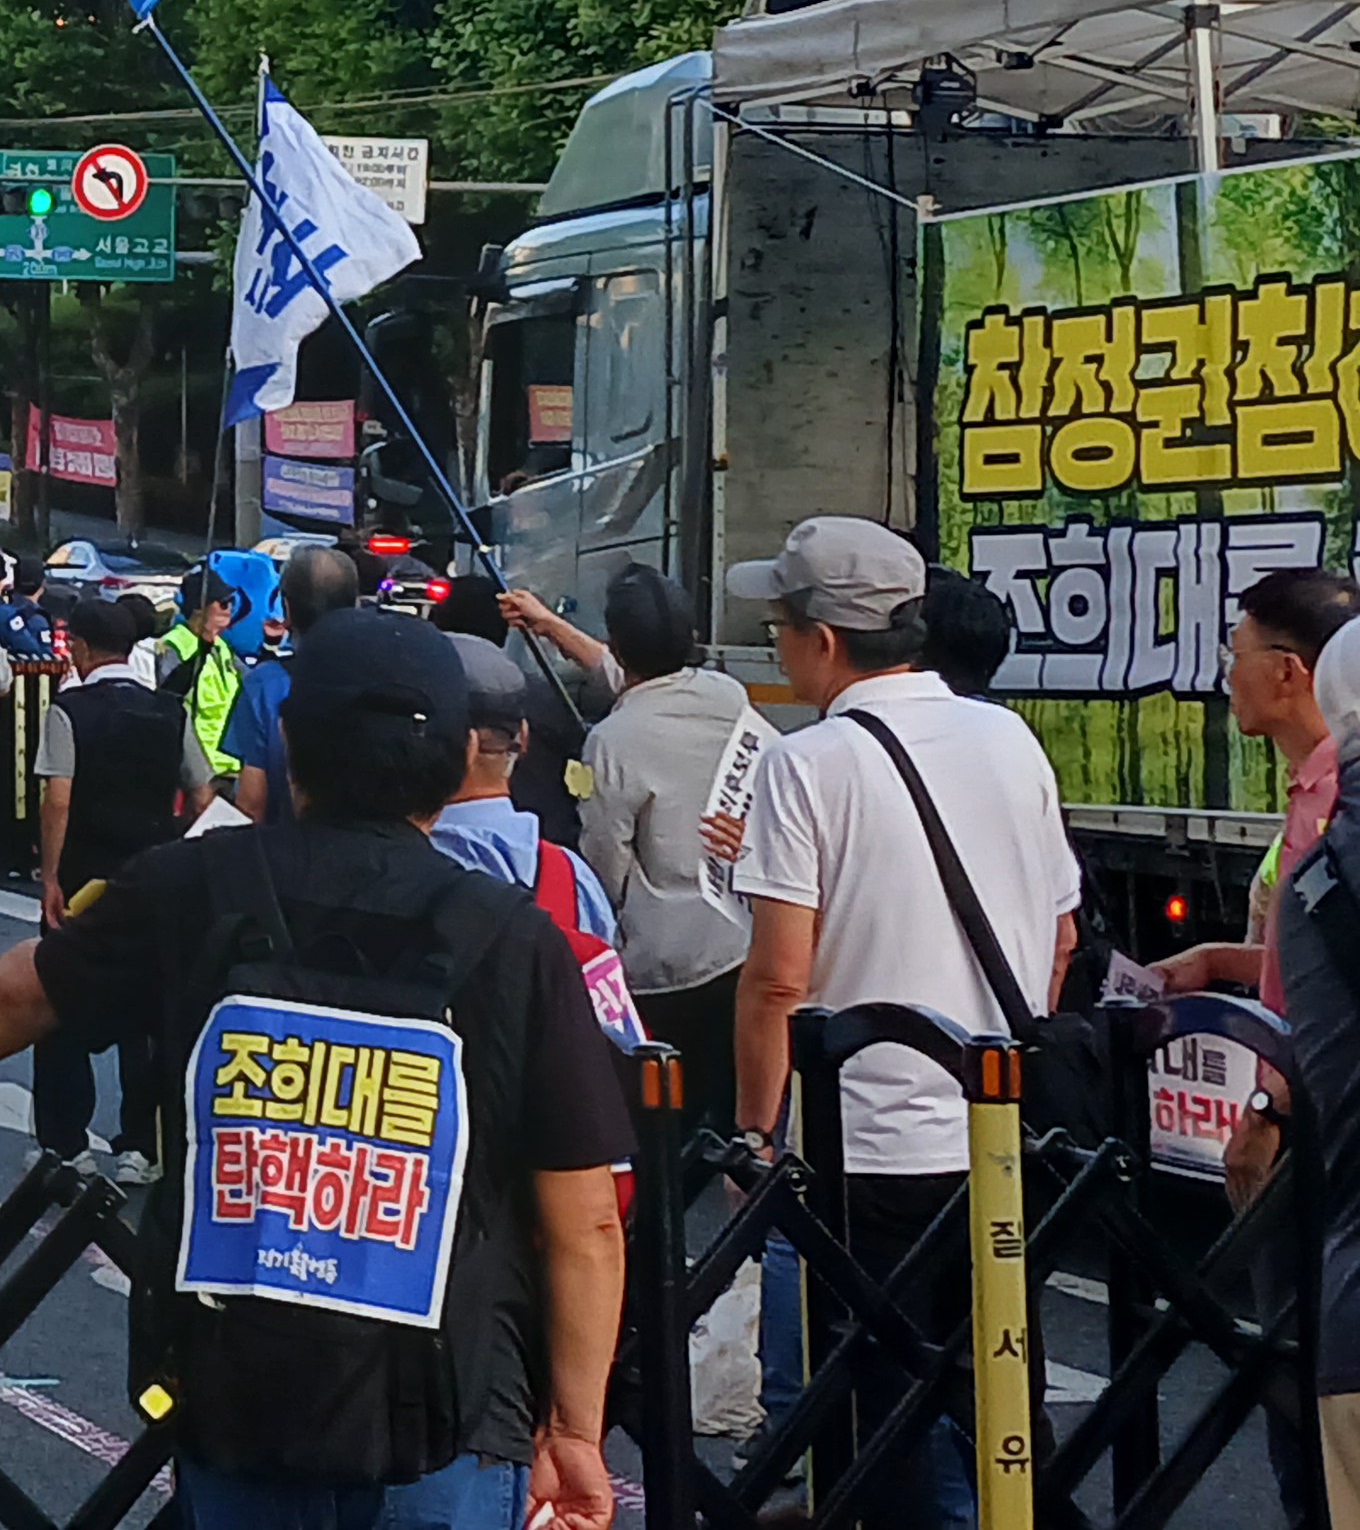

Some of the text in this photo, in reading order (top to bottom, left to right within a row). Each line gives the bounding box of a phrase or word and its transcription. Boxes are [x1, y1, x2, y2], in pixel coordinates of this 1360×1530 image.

[962, 281, 1360, 496] 참정권침
[212, 1030, 441, 1149] 조희대를
[210, 1126, 431, 1251] 탄핵하라
